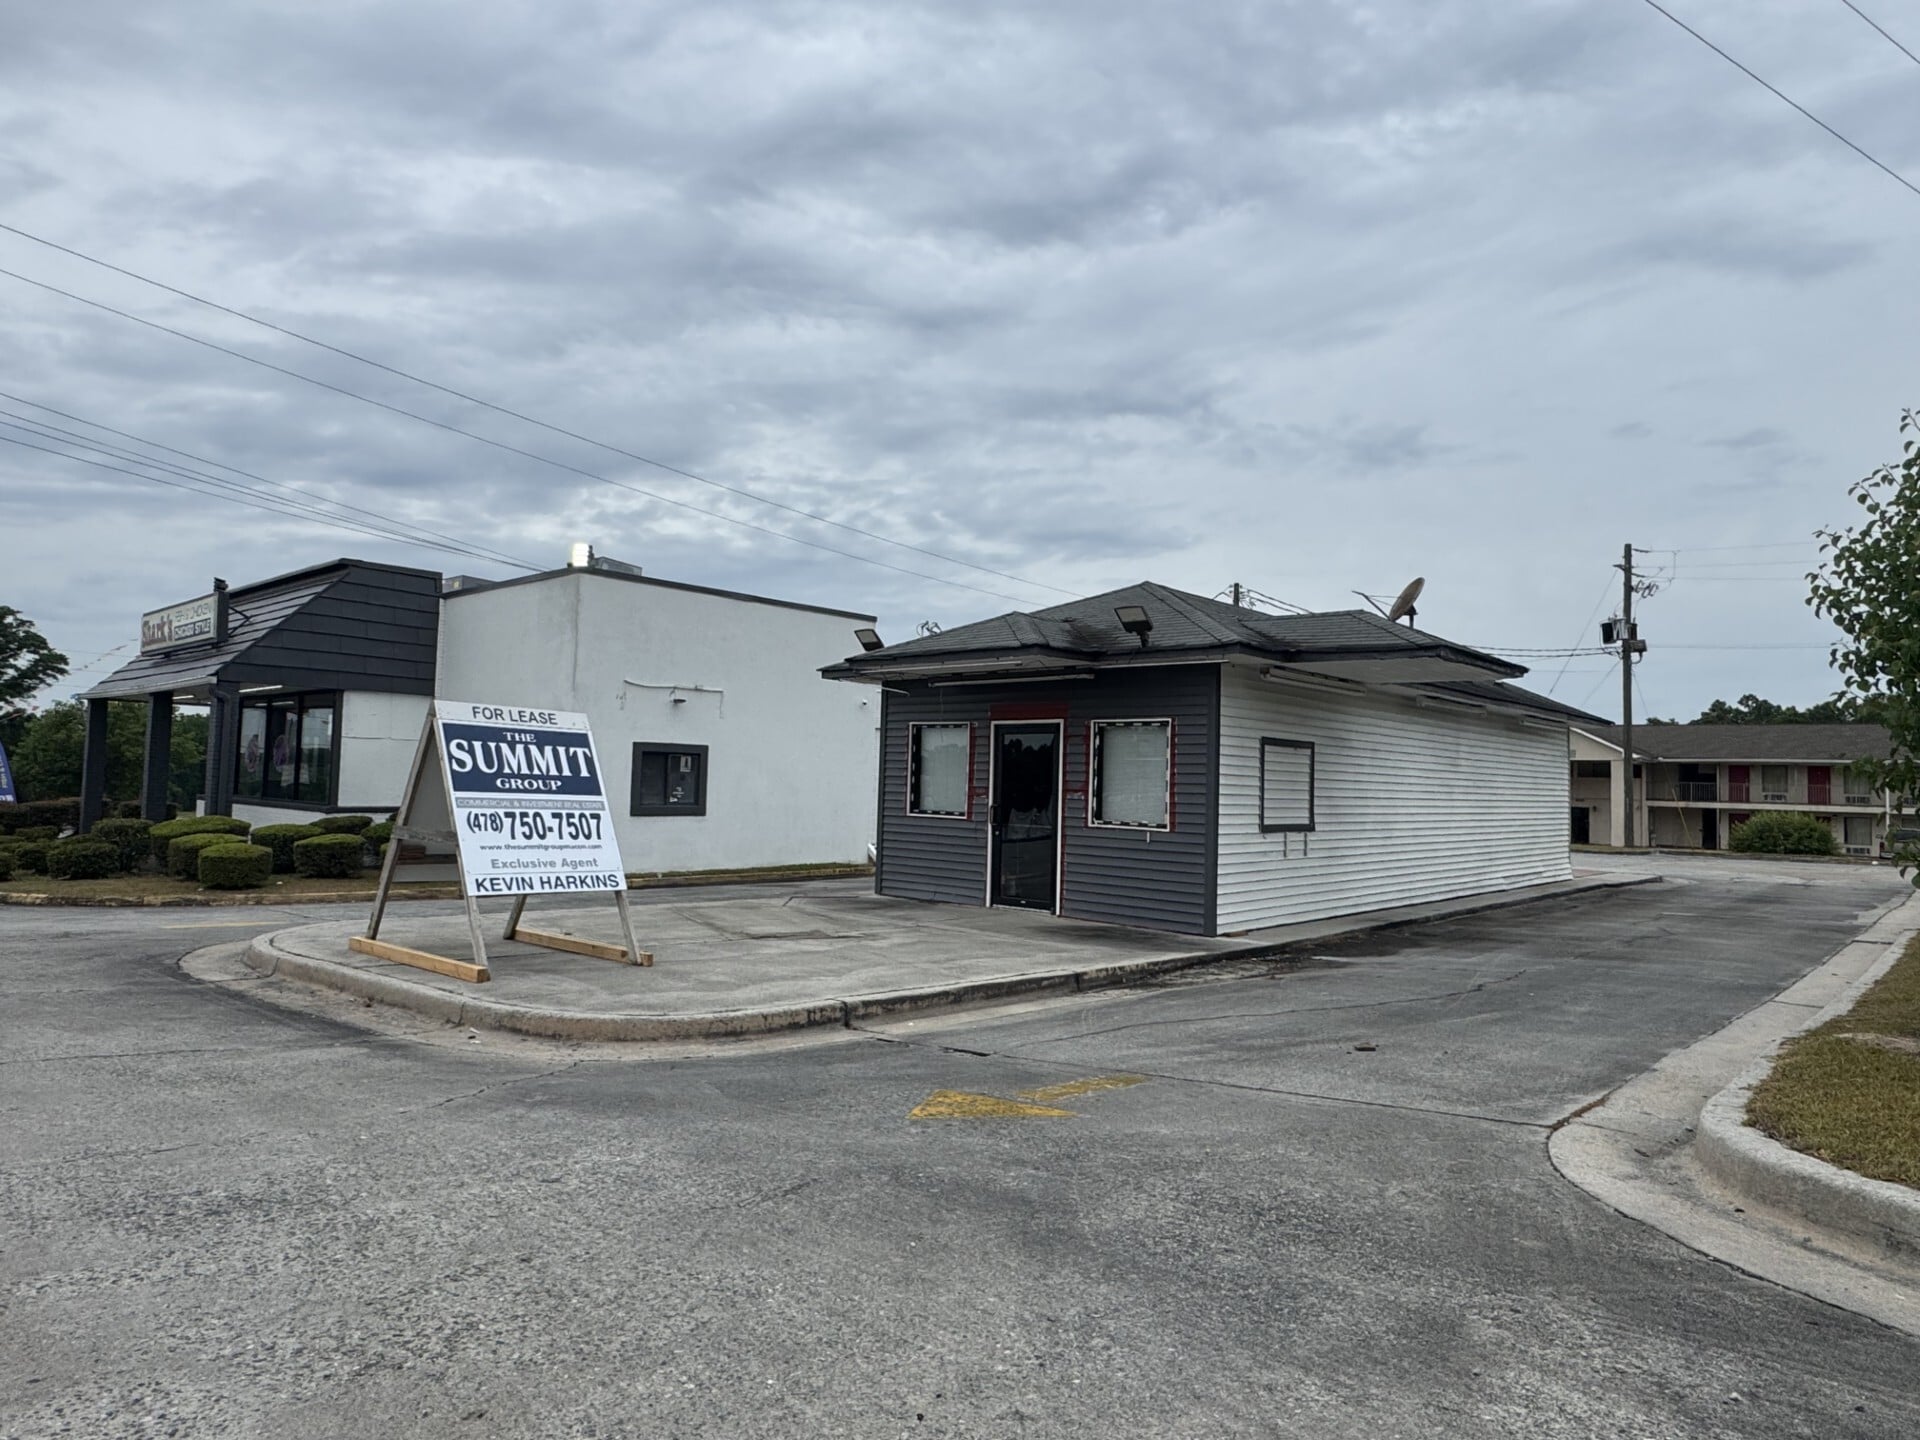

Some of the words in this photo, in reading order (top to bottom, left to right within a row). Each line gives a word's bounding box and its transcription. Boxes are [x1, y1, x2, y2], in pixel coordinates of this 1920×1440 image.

[472, 706, 505, 721] FOR
[508, 709, 558, 725] LEASE
[503, 731, 537, 743] THE
[449, 739, 592, 777] SUMMIT
[496, 778, 562, 791] GROUP
[467, 810, 504, 834] (478)
[504, 811, 602, 840] 750-7507
[491, 858, 557, 869] Exclusive
[561, 857, 599, 870] Agent
[475, 876, 534, 892] KEVIN
[540, 874, 620, 890] HARKINS
